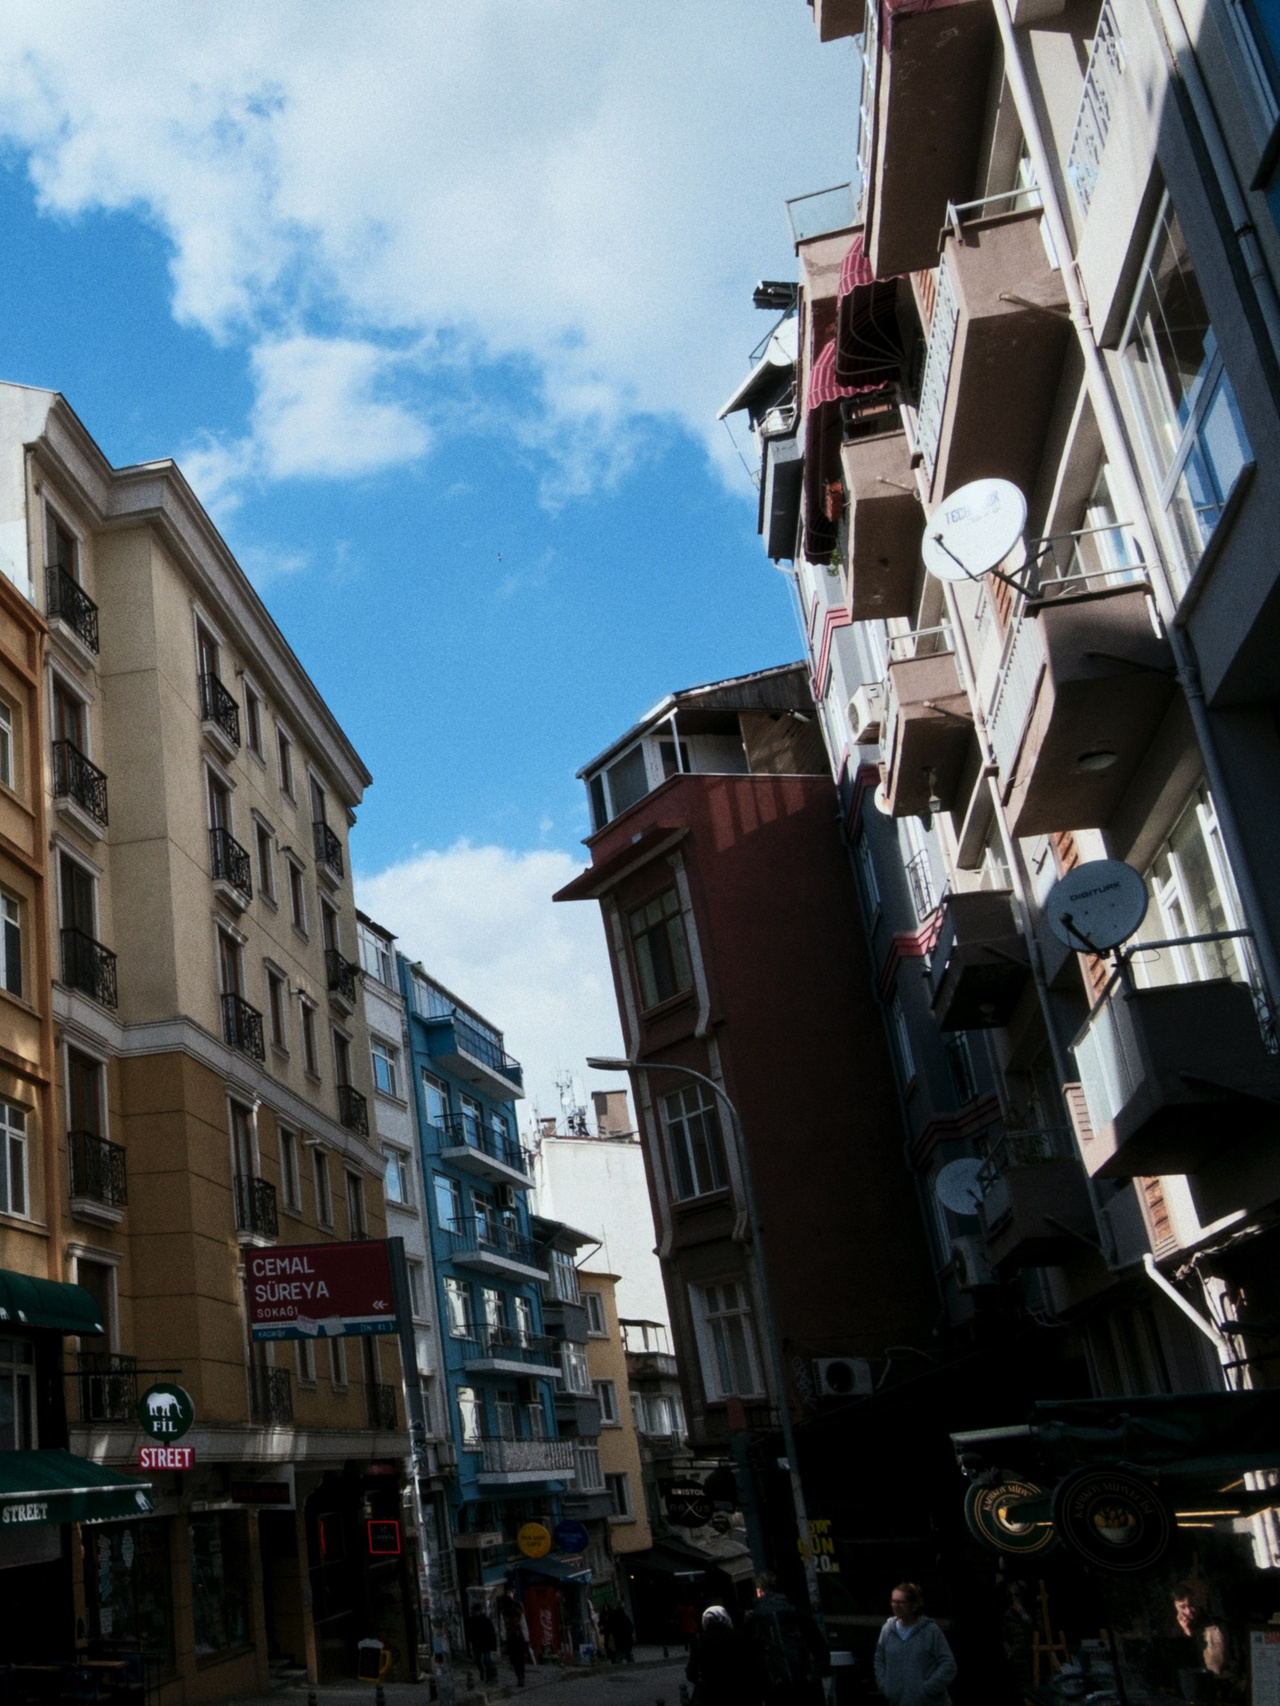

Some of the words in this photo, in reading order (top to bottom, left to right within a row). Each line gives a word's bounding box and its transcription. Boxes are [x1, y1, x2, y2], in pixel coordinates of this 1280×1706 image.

[1070, 881, 1120, 901] DIGITURK
[252, 1256, 315, 1277] CEMAL
[255, 1280, 330, 1303] SÜREYA
[257, 1306, 299, 1318] SOKAĞI
[152, 1418, 178, 1433] FİL
[141, 1447, 191, 1468] STREET
[2, 1502, 48, 1524] STREET
